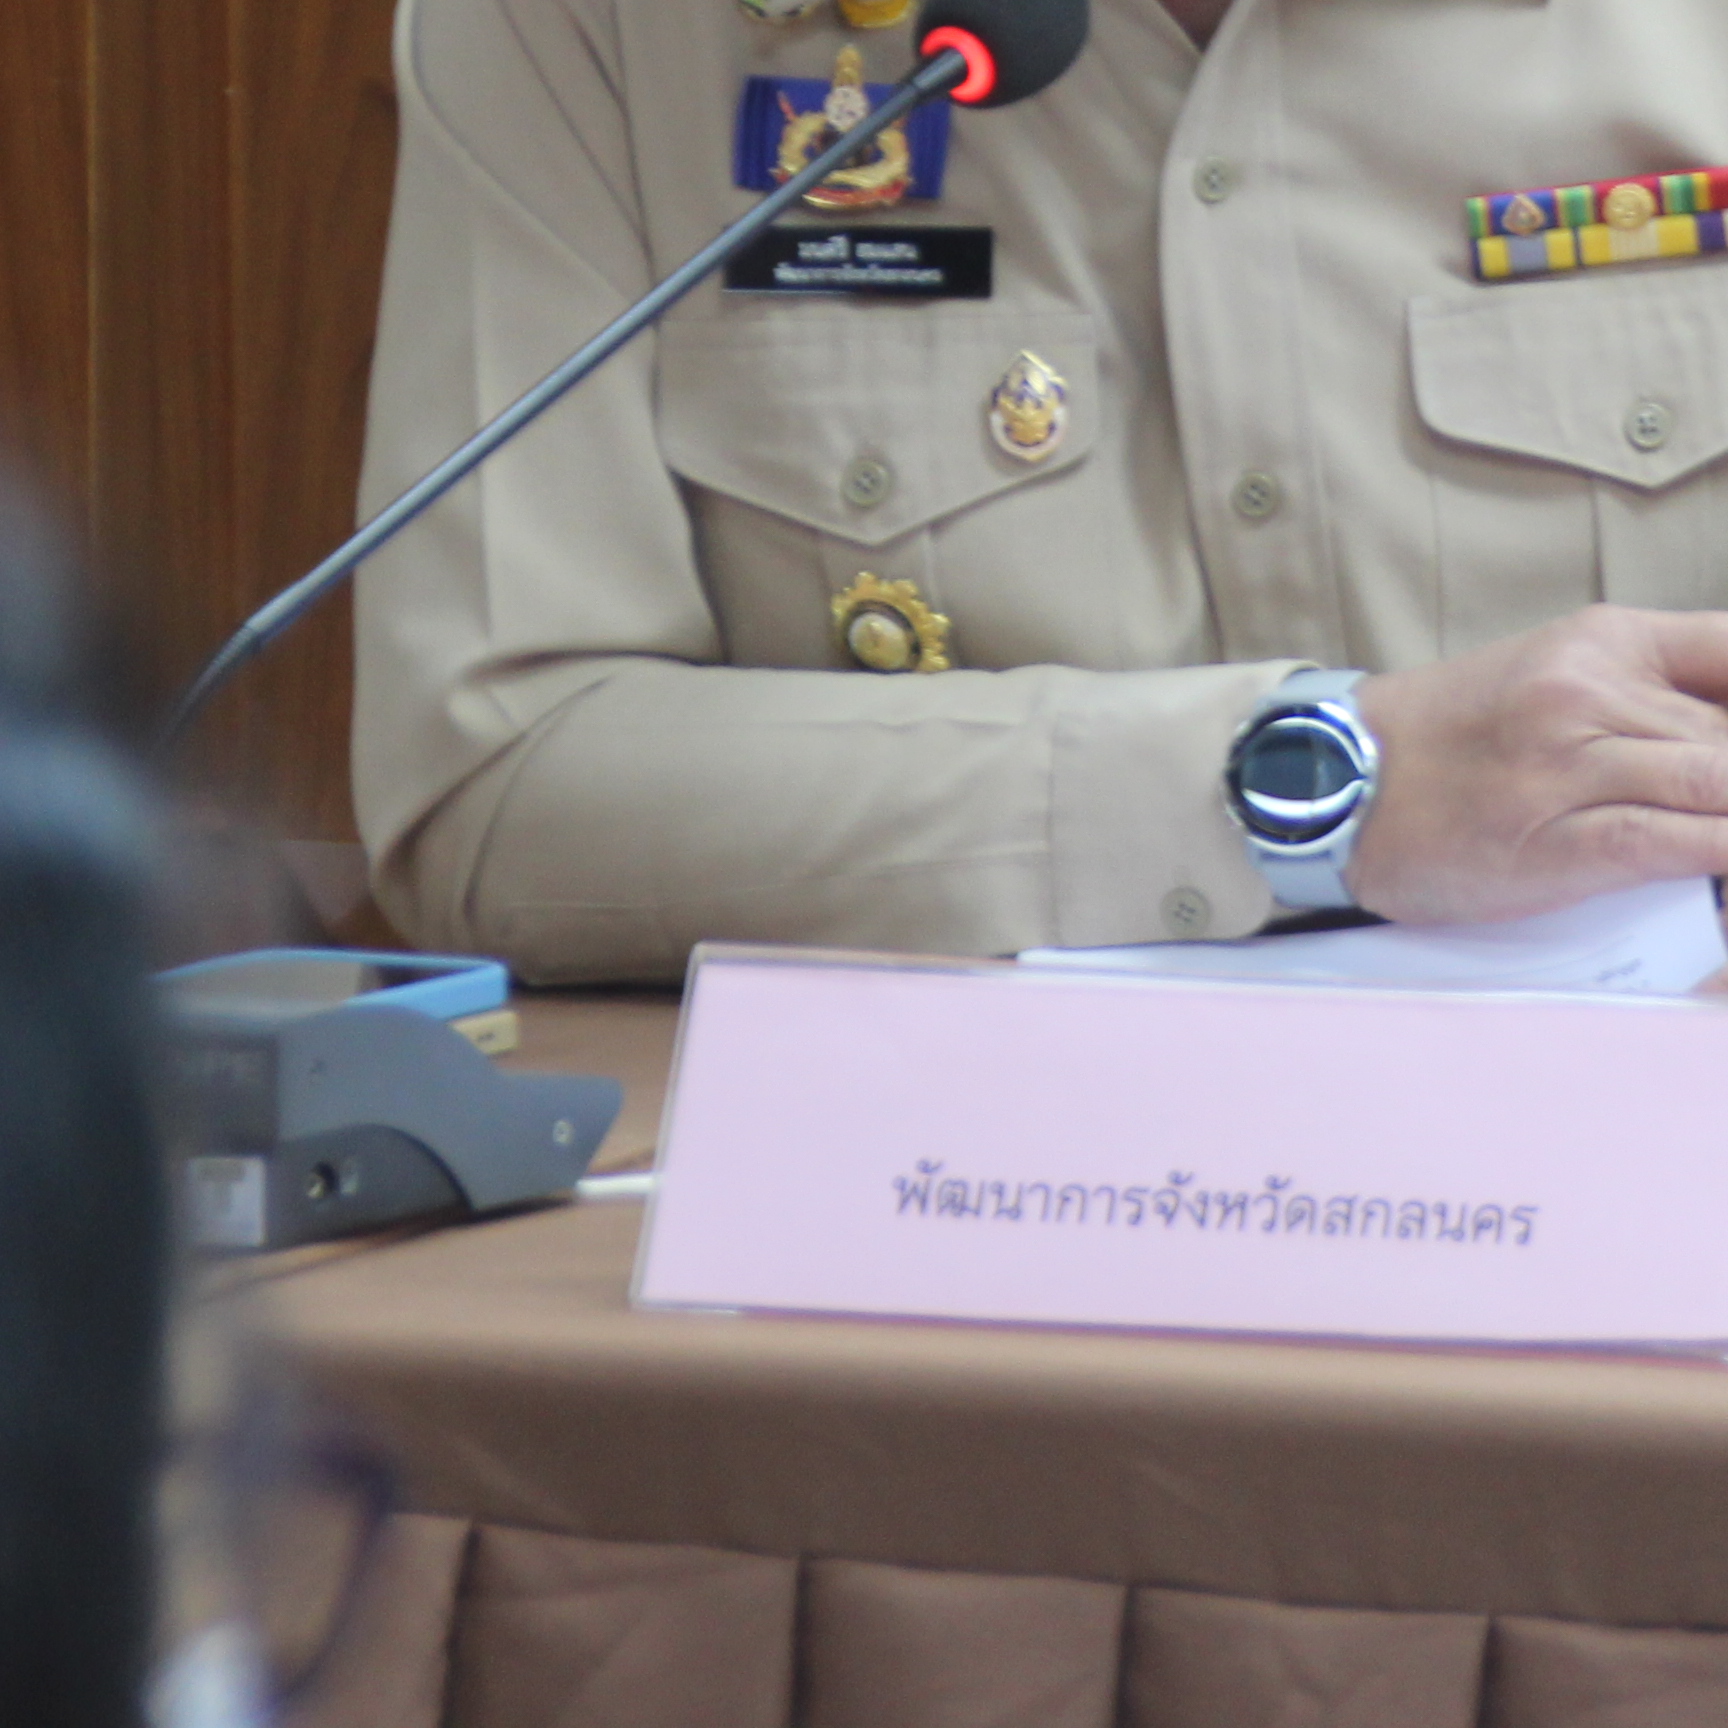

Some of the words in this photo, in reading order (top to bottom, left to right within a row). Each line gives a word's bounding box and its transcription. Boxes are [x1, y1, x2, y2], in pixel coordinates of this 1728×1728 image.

[894, 1158, 1537, 1246] พัฒนาการจังหวัดสกลนคร
